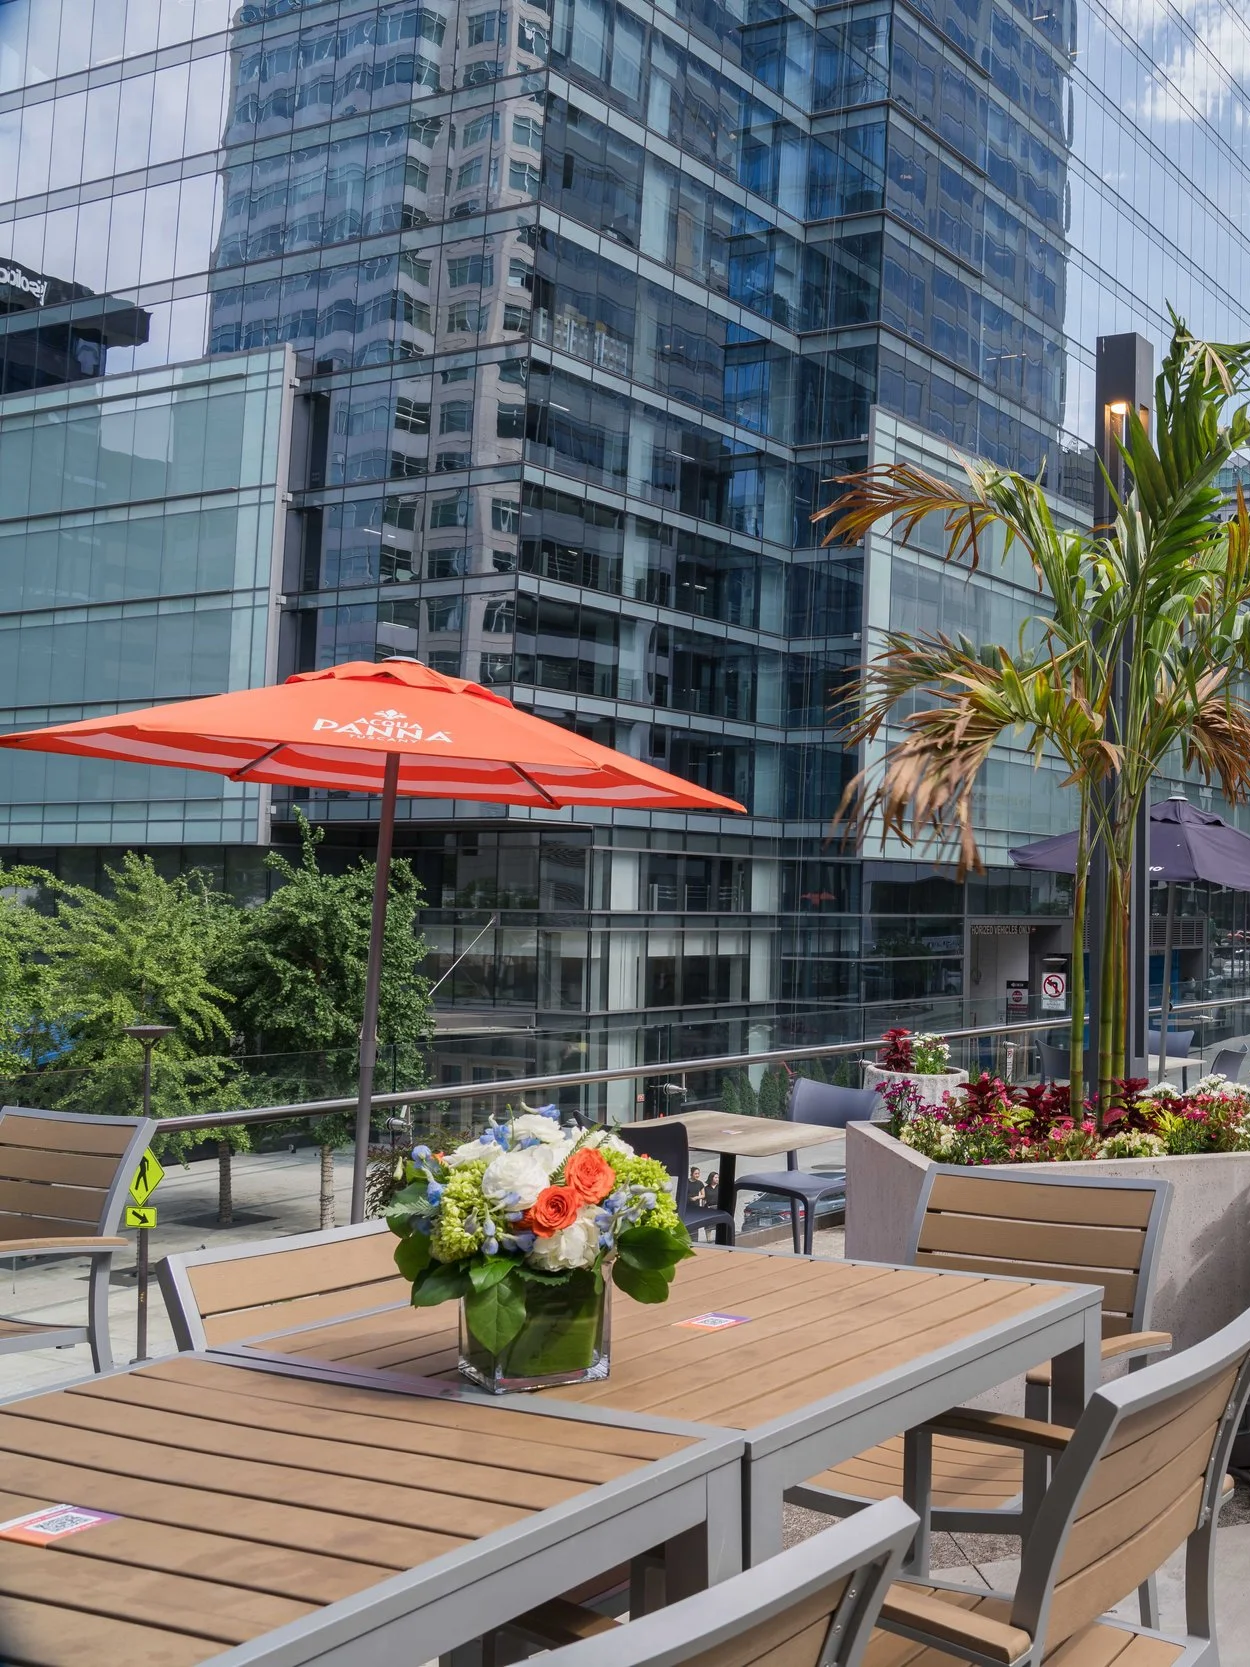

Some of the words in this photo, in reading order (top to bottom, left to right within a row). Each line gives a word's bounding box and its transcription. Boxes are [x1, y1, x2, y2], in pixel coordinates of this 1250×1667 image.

[354, 717, 423, 730] ACQUA
[312, 718, 453, 743] PANNA
[350, 734, 419, 743] TUSCANY
[971, 925, 993, 935] HORIZED
